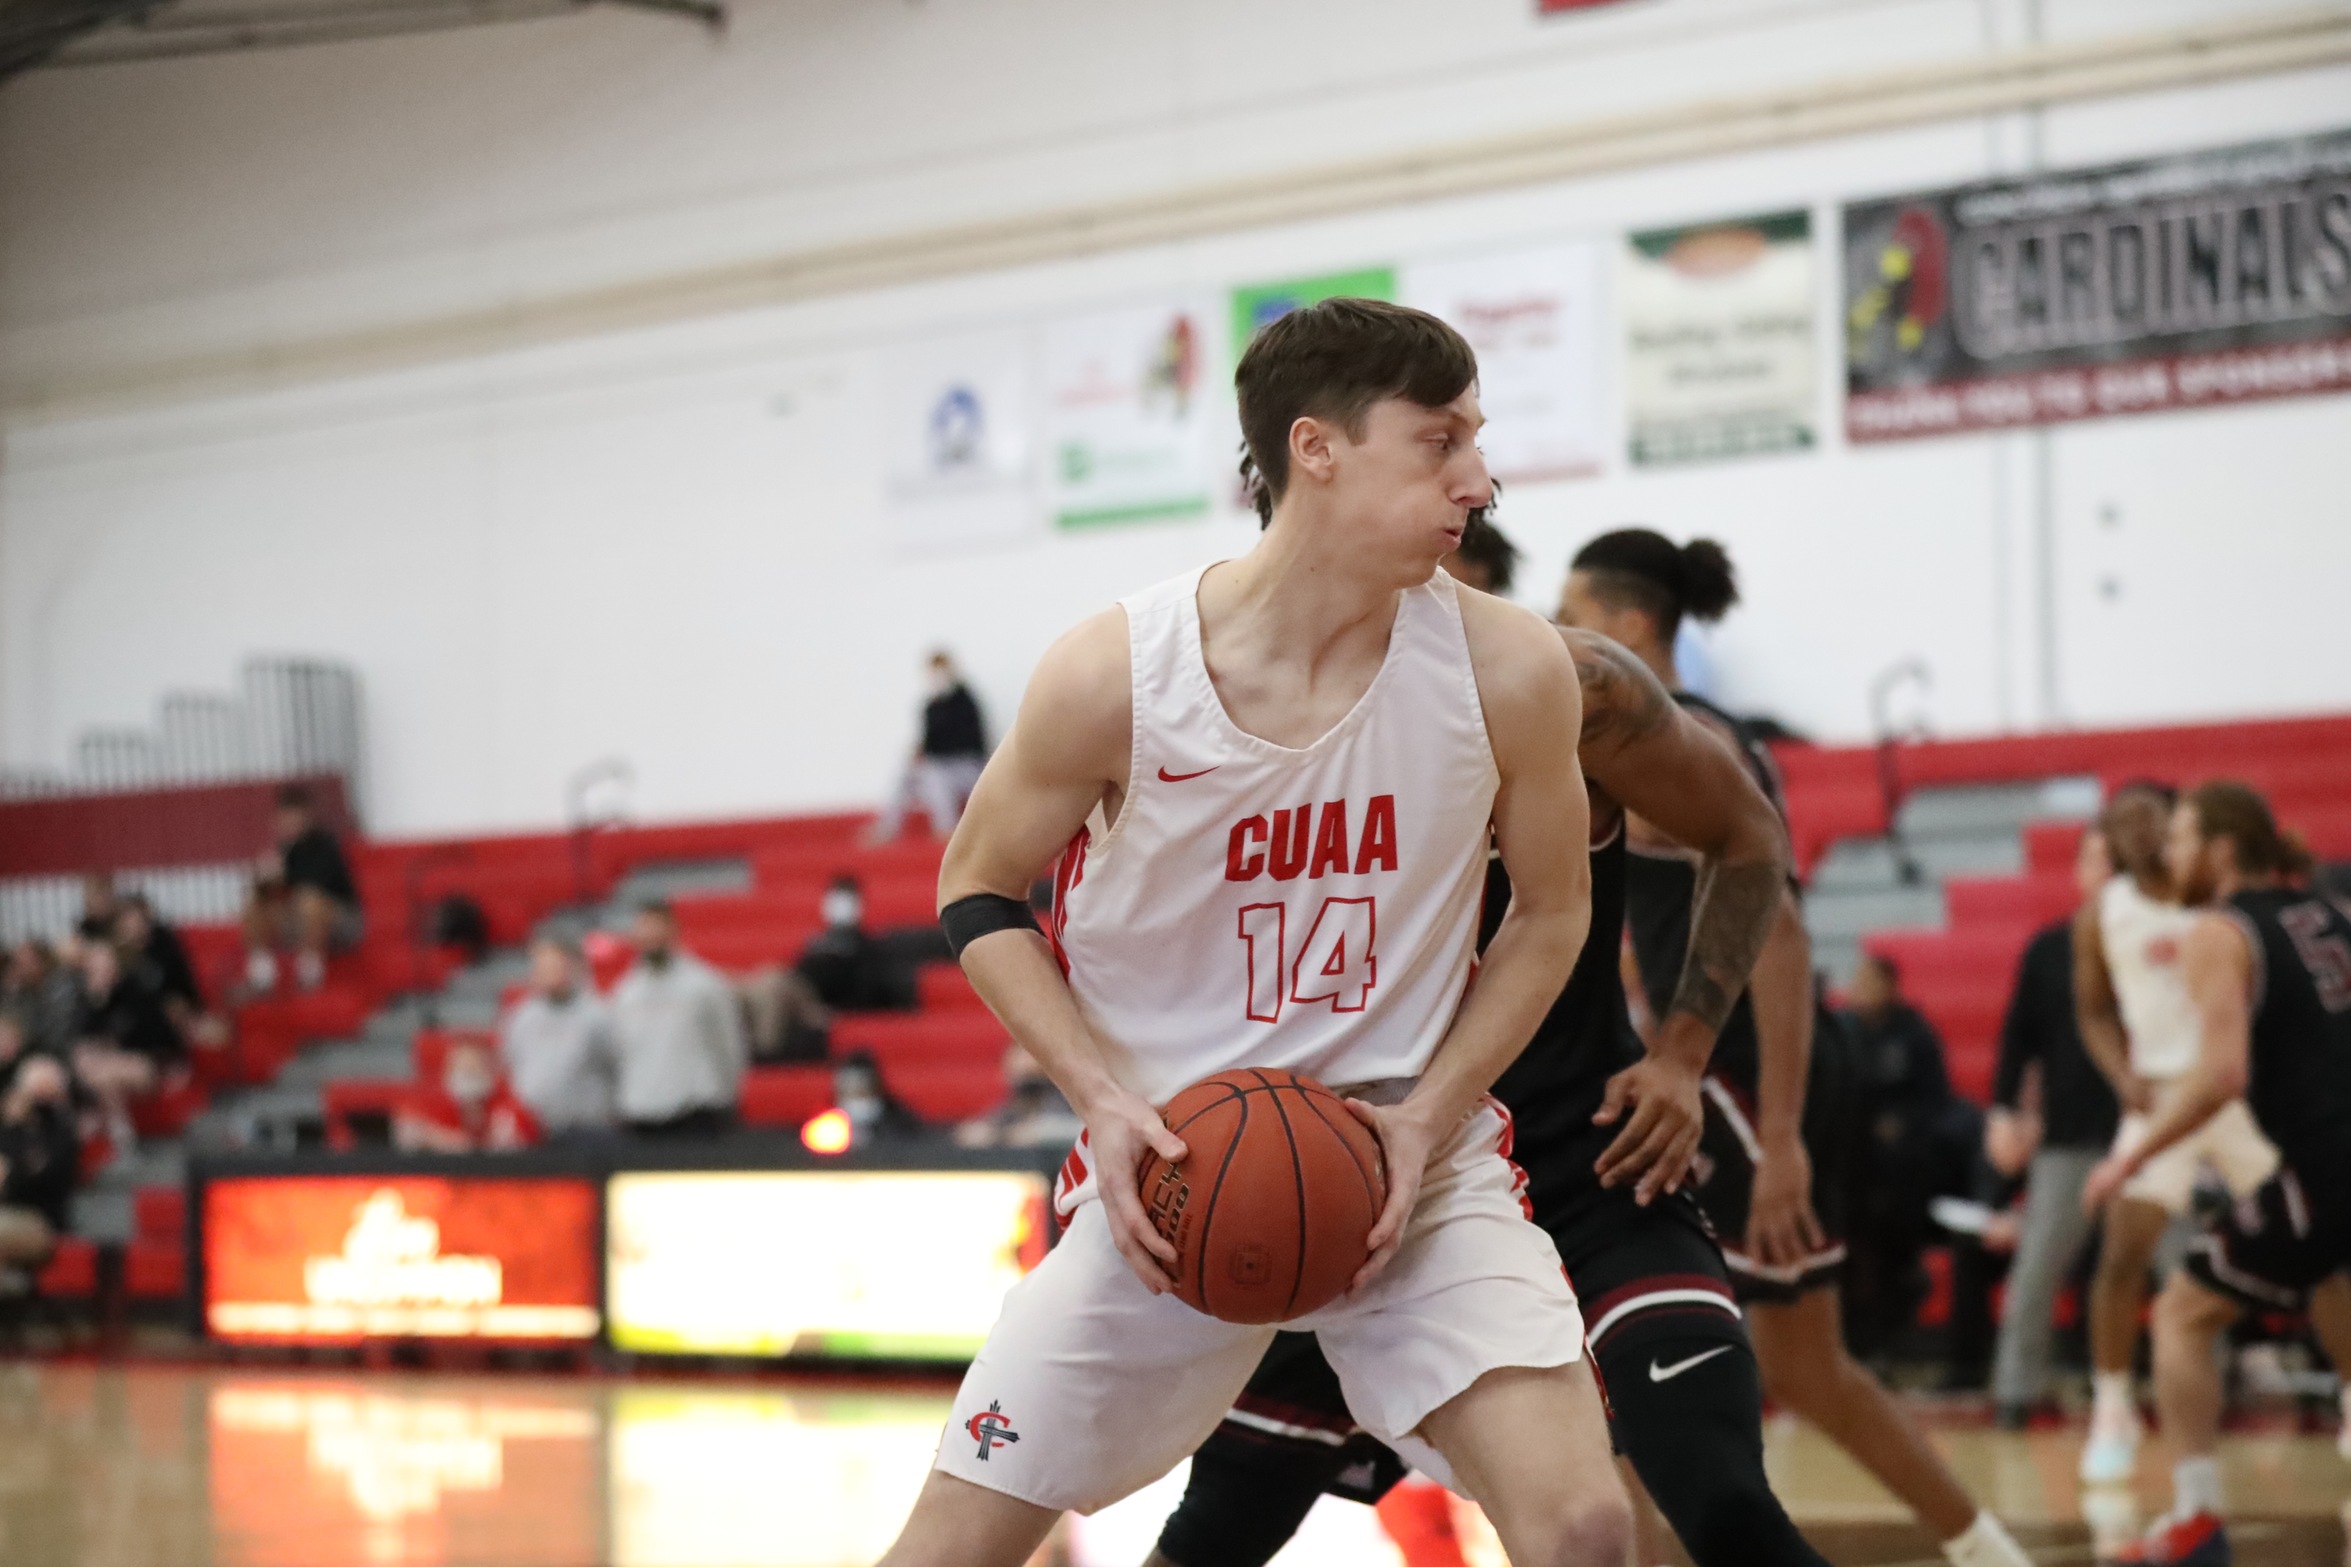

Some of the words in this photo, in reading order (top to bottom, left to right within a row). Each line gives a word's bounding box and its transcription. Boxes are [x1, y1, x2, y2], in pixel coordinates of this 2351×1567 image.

[1955, 176, 2351, 360] CARDINALS
[1225, 794, 1398, 882] CUAA
[1238, 896, 1377, 1024] 14
